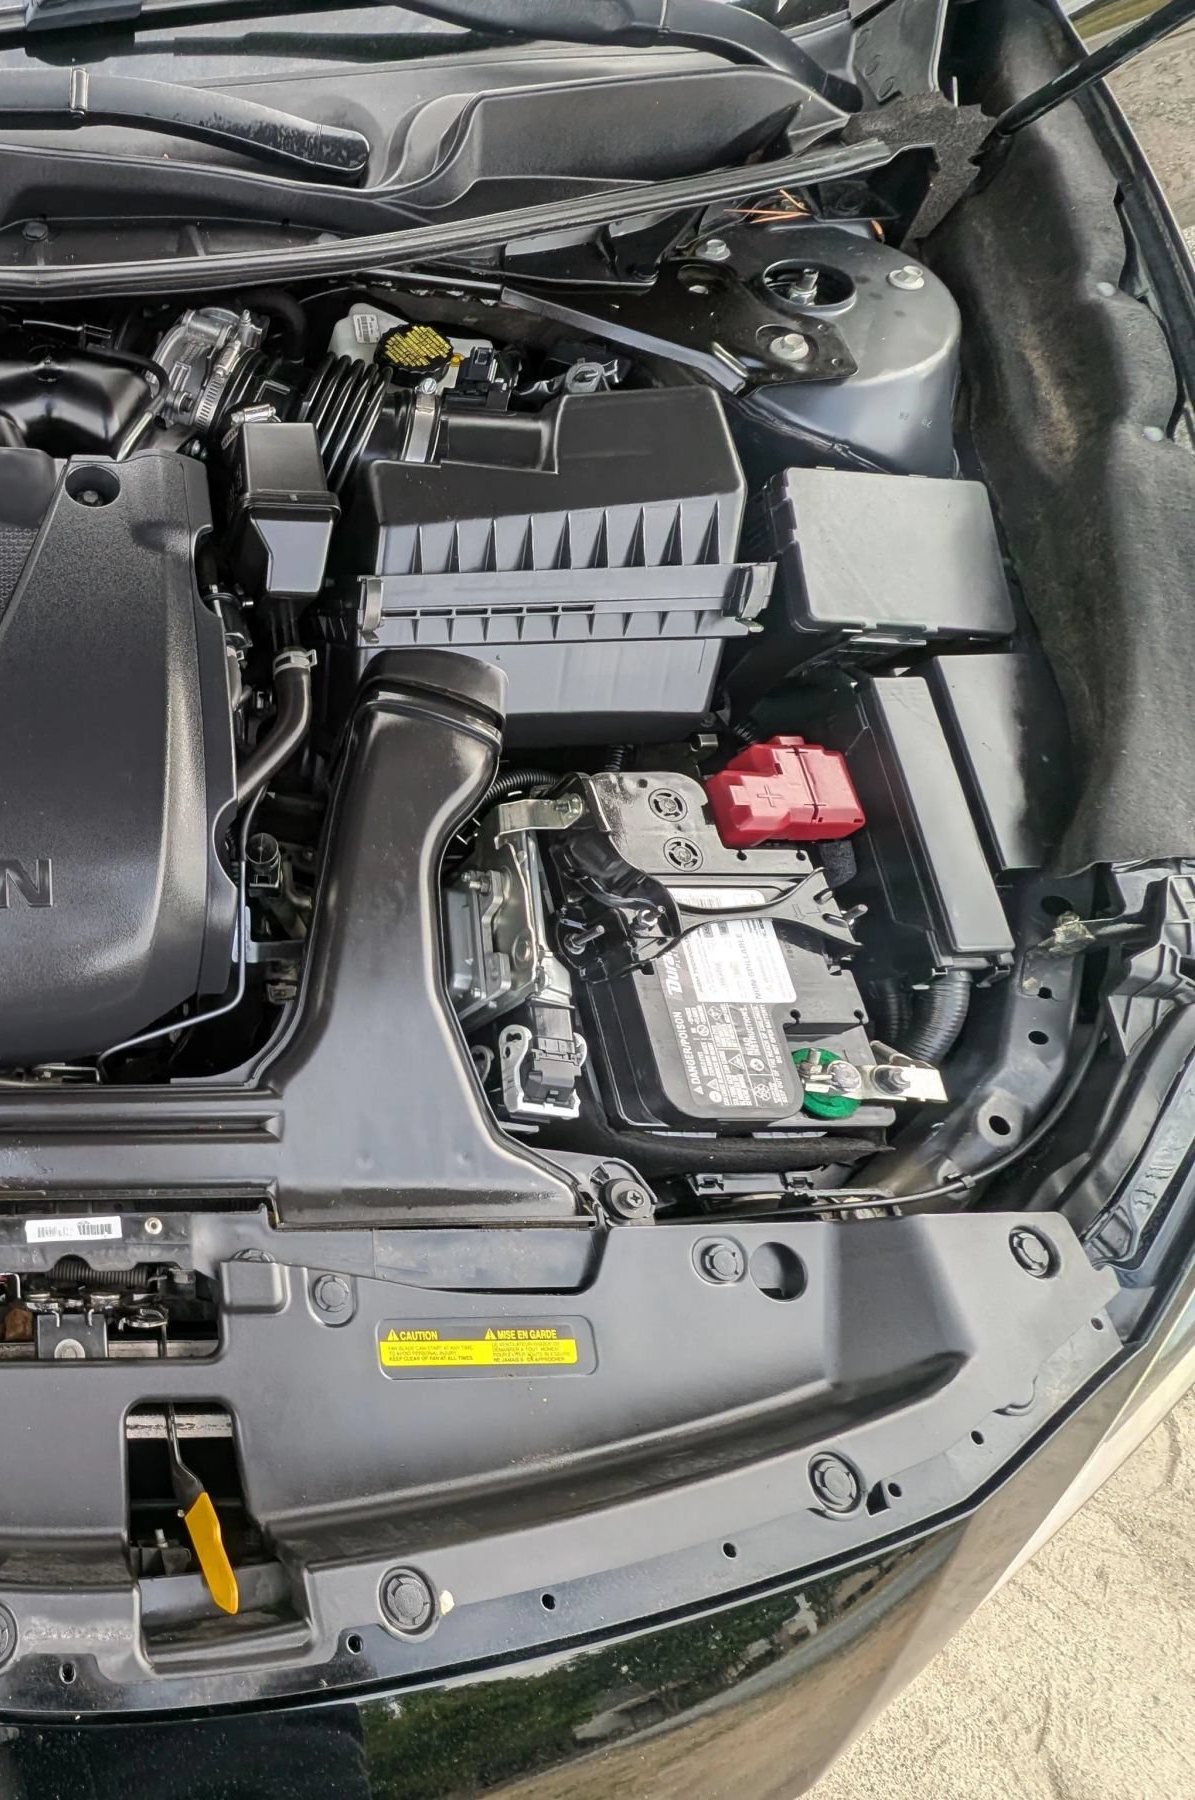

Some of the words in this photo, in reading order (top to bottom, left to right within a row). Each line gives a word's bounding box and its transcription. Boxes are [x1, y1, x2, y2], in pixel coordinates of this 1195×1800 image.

[673, 1011, 701, 1085] DANGER/POISON
[399, 1330, 438, 1341] CAUTION
[497, 1330, 516, 1339] MISE
[517, 1330, 529, 1339] EN
[530, 1329, 557, 1339] GARDE
